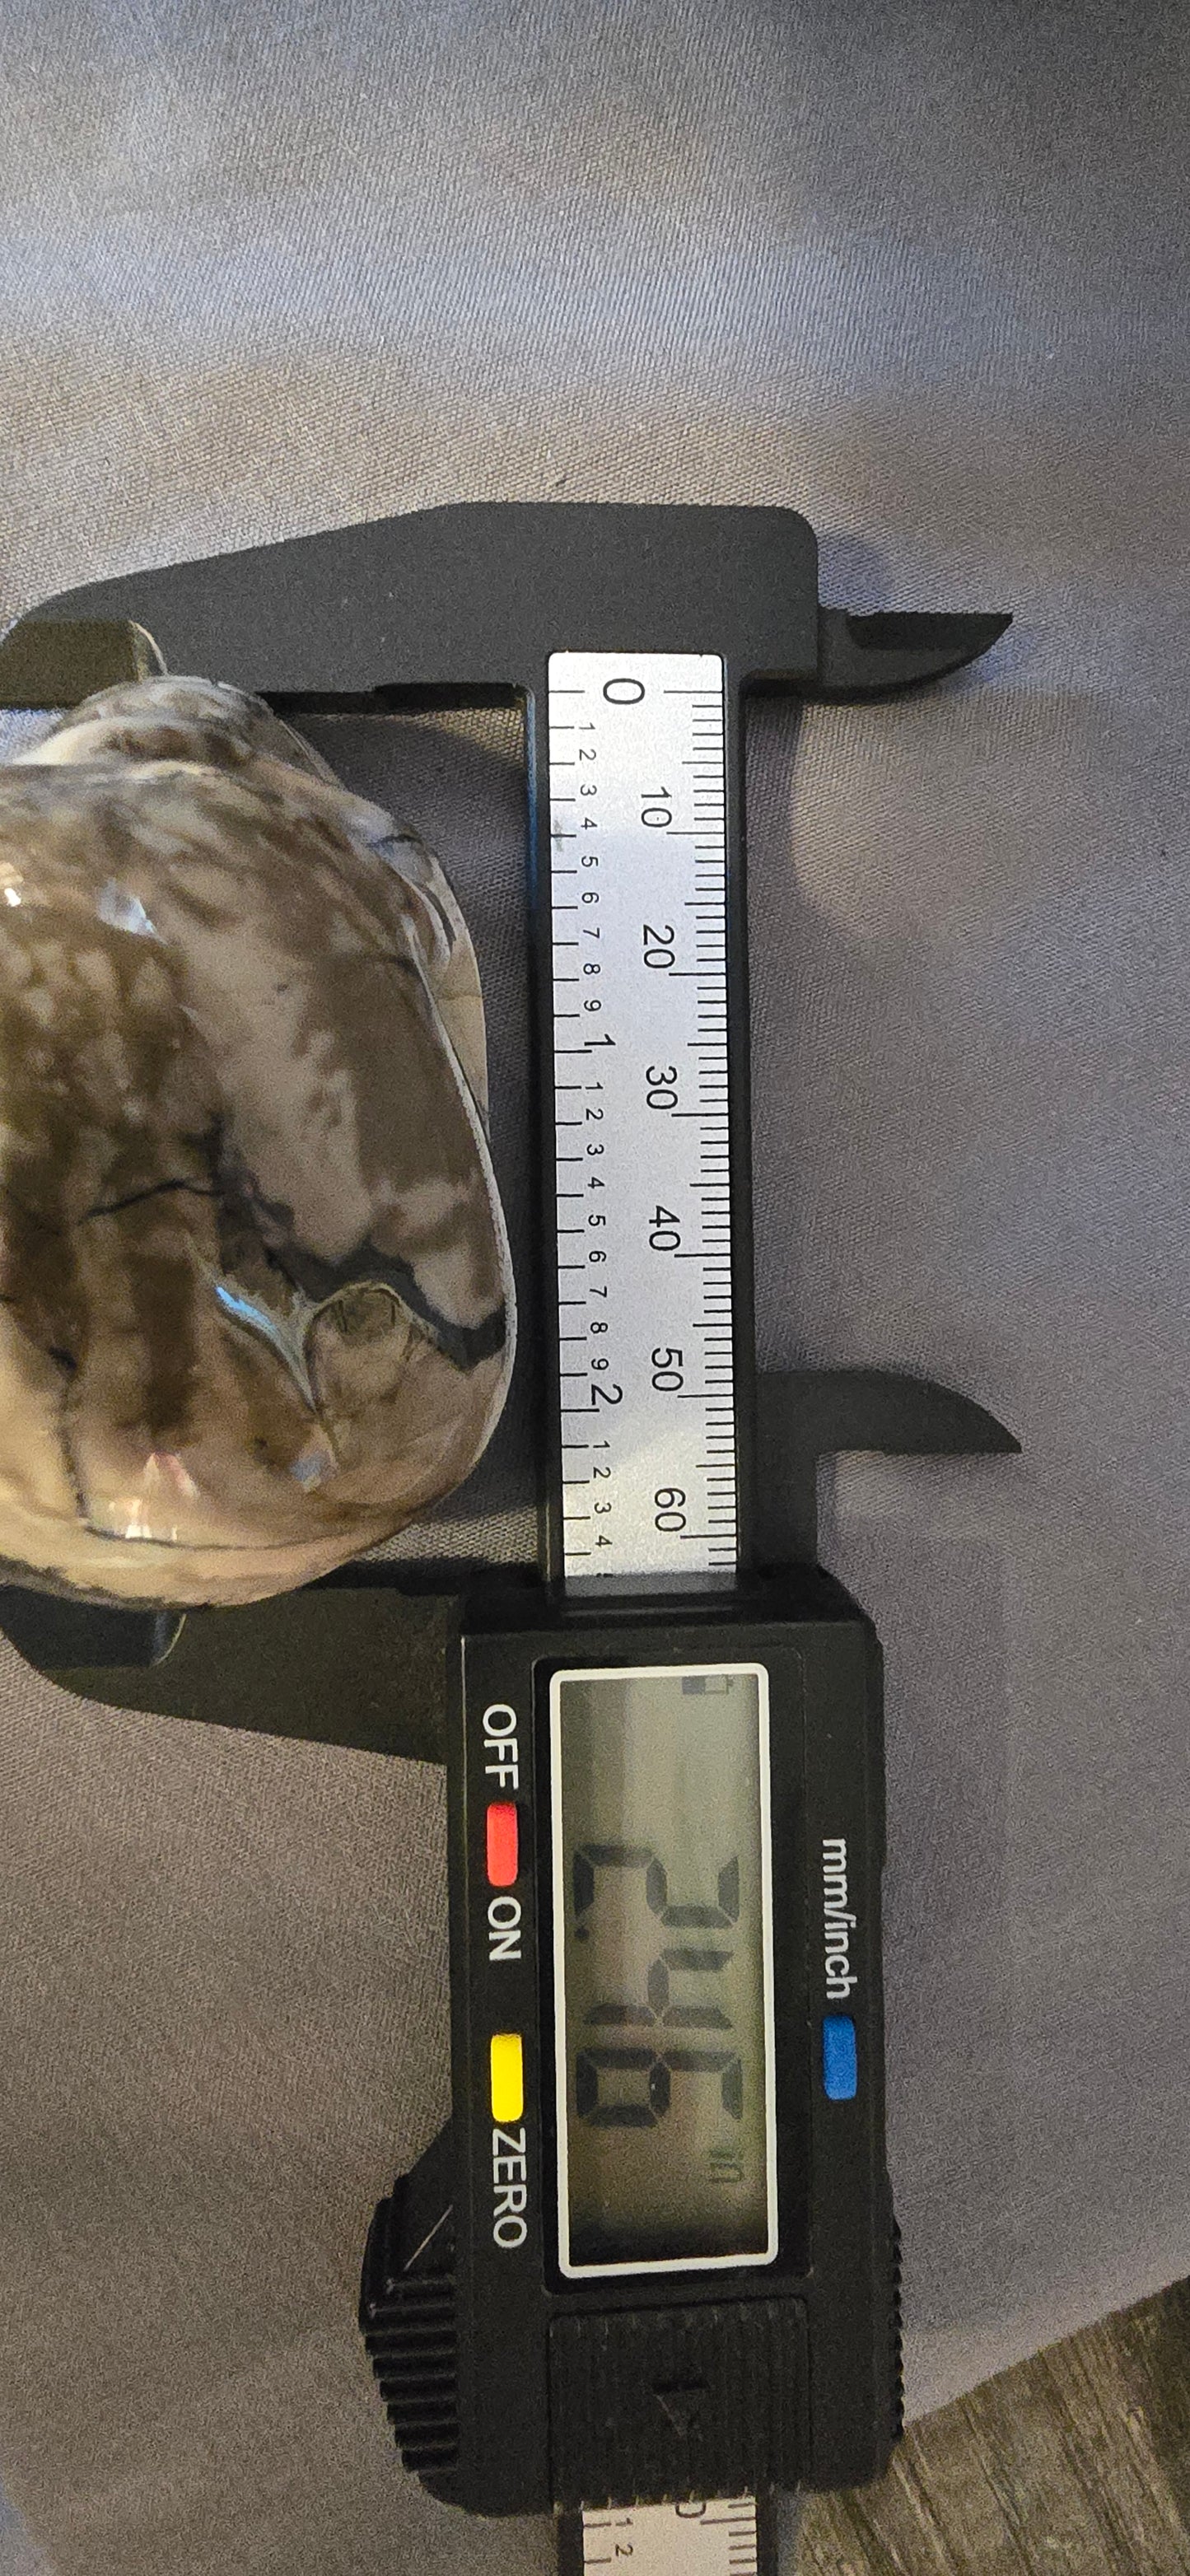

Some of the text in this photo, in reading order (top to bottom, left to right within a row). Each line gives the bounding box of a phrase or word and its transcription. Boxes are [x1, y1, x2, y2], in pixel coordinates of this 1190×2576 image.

[604, 679, 645, 704] 0
[579, 749, 596, 761] 2
[580, 784, 597, 796] 3
[641, 787, 672, 828] 10
[581, 818, 597, 829] 4
[581, 856, 598, 867] 5
[581, 891, 599, 904] 6
[583, 927, 600, 938] 7
[643, 924, 675, 968] 20
[583, 964, 600, 975] 8
[584, 1000, 601, 1011] 9
[585, 1034, 616, 1046] 1
[646, 1066, 678, 1109] 30
[586, 1108, 603, 1120] 2
[586, 1144, 604, 1155] 3
[587, 1177, 604, 1188] 4
[588, 1214, 605, 1226] 5
[649, 1206, 681, 1251] 40
[589, 1250, 606, 1262] 6
[590, 1286, 607, 1298] 7
[590, 1322, 608, 1334] 8
[591, 1358, 609, 1370] 9
[651, 1348, 684, 1392] 50
[591, 1384, 623, 1405] 2
[593, 1441, 610, 1449] 1
[594, 1467, 611, 1479] 2
[595, 1502, 611, 1514] 3
[655, 1487, 686, 1532] 60
[595, 1535, 612, 1547] 4
[482, 1703, 519, 1791] OFF
[821, 1836, 858, 2000] mm/inch
[487, 1895, 522, 1961] ON
[708, 2150, 744, 2185] in
[492, 2126, 528, 2249] ZERO
[615, 2543, 633, 2557] 2
